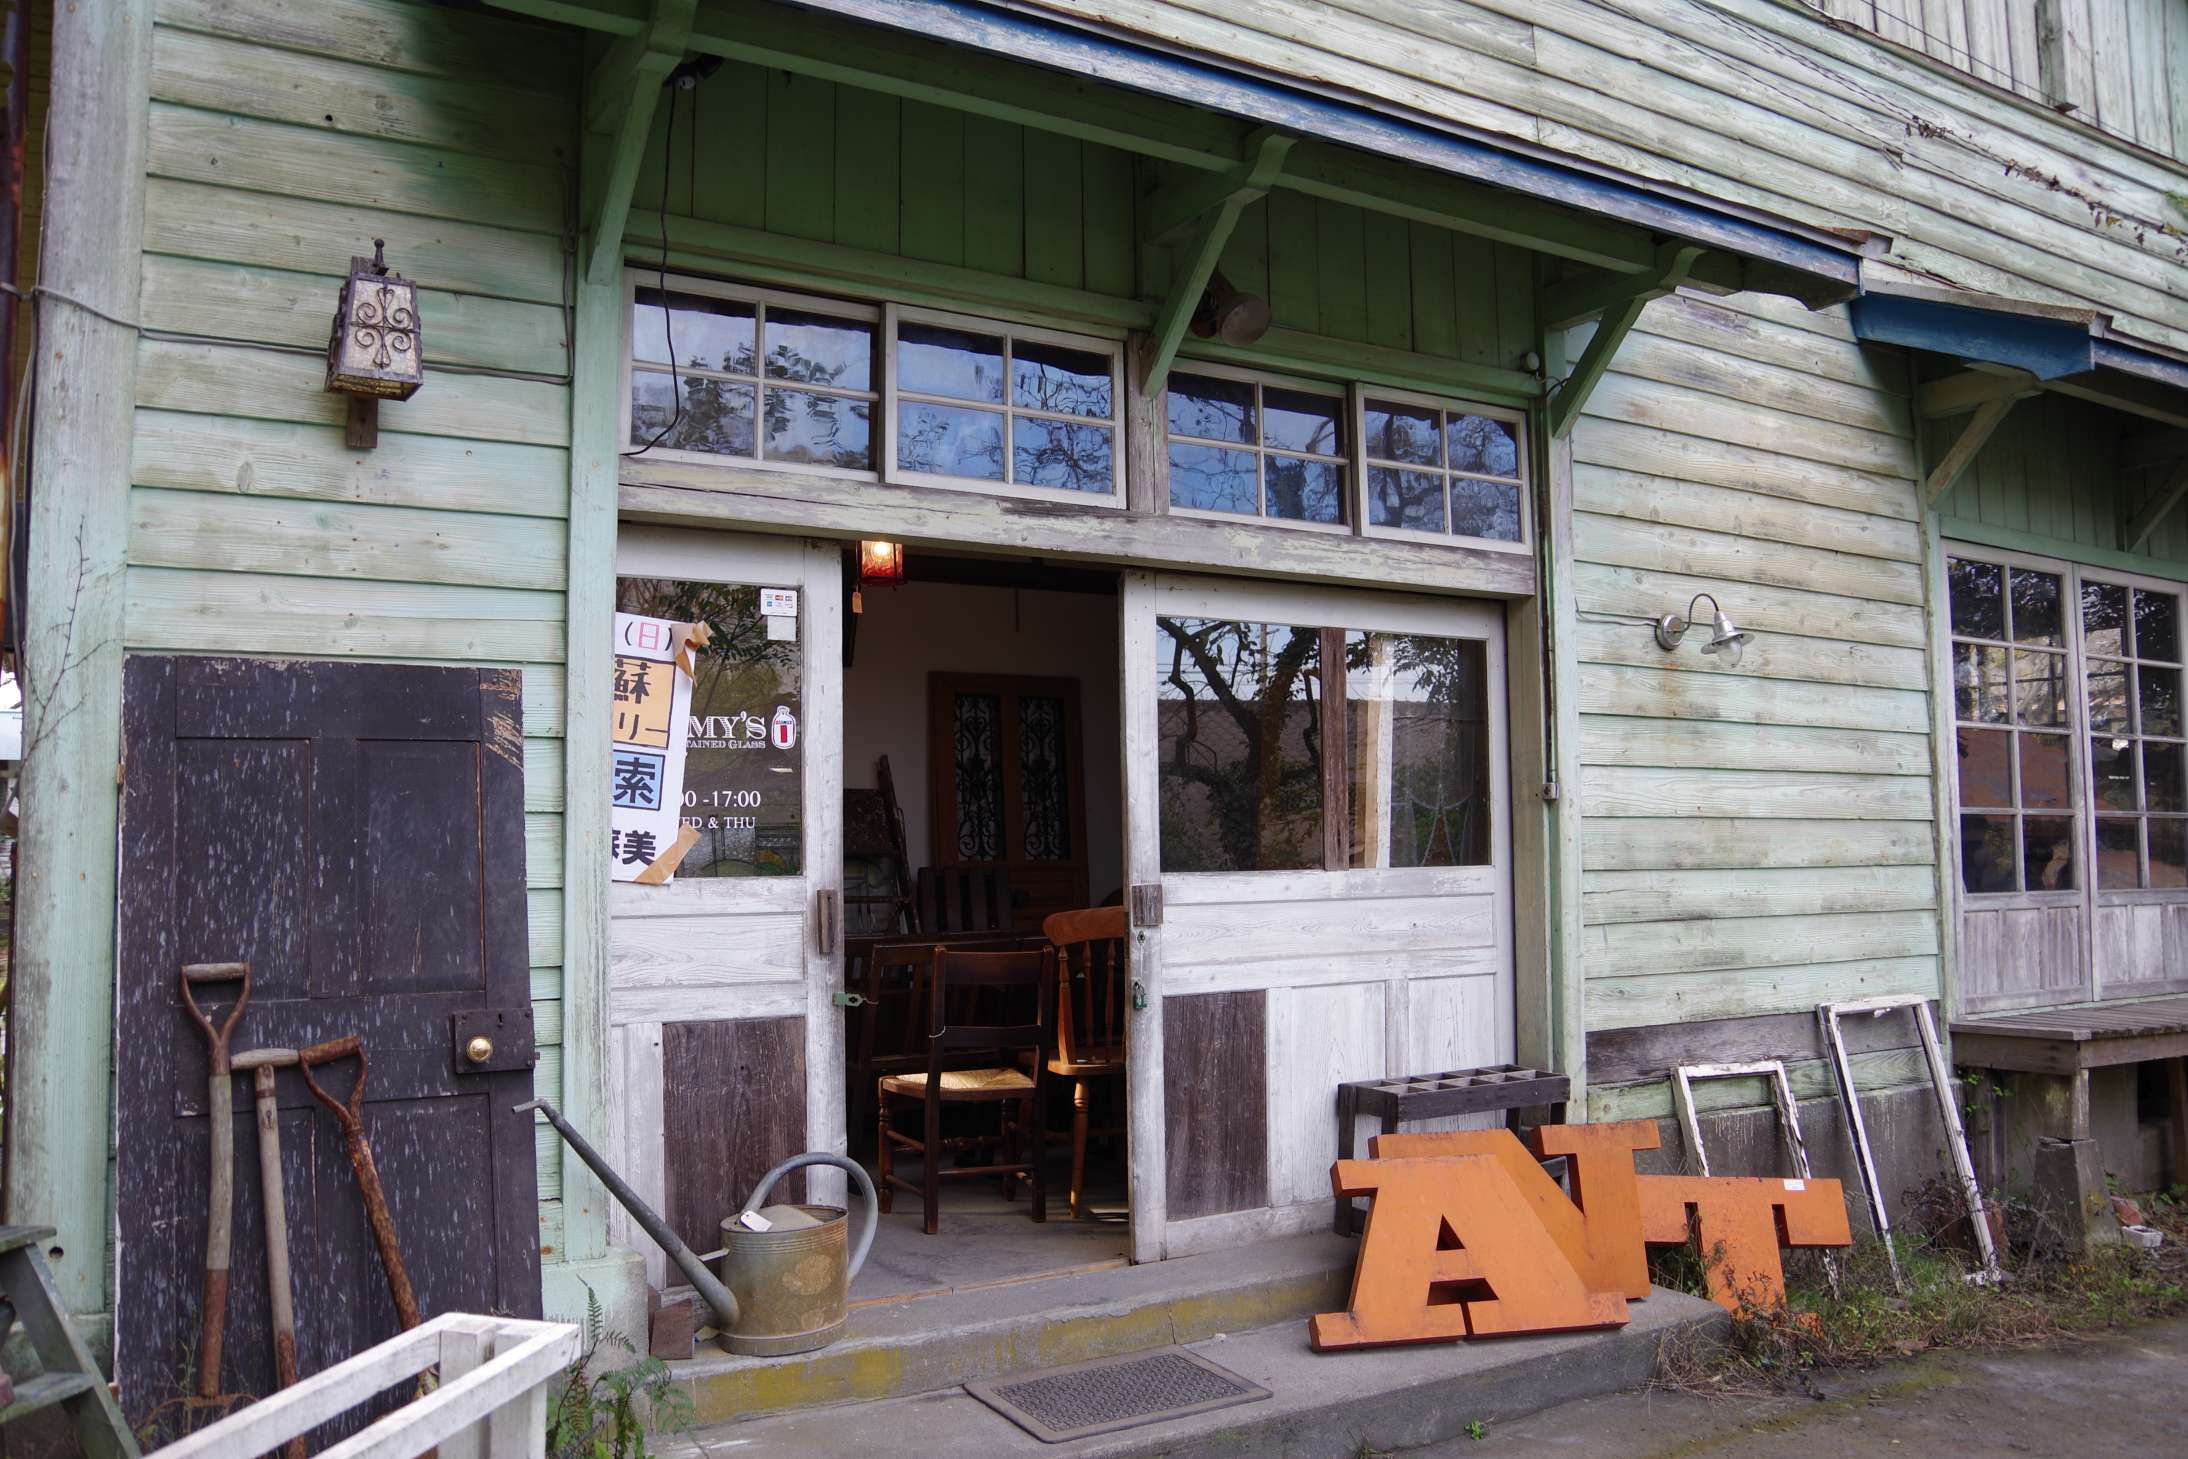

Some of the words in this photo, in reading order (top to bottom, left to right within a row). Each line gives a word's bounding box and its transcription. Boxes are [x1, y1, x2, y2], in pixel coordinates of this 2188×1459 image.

[618, 712, 669, 741] リー
[613, 756, 656, 805] 索
[678, 816, 703, 829] ED
[708, 816, 719, 829] &
[723, 816, 756, 829] THU
